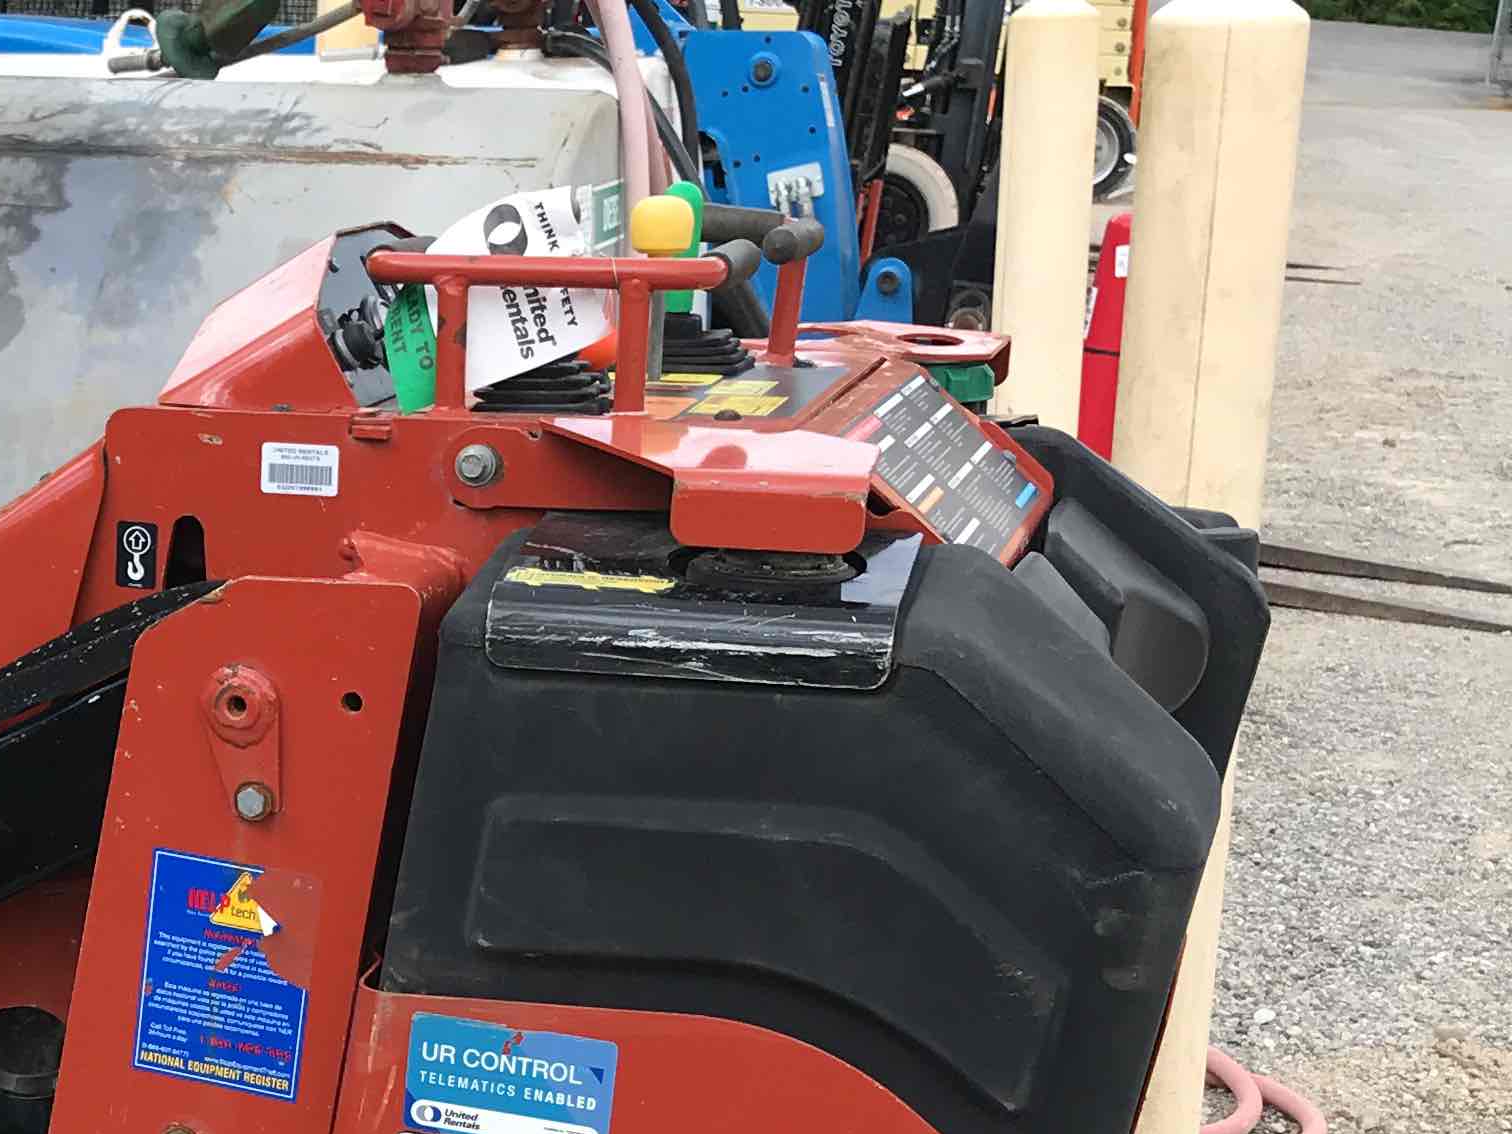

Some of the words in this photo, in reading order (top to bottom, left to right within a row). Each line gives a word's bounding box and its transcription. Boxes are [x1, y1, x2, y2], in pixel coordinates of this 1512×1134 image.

[534, 201, 560, 253] THINK
[559, 288, 578, 329] FETY
[500, 286, 536, 360] entals
[523, 286, 555, 345] nited
[415, 341, 435, 371] TO
[140, 1049, 185, 1070] NATIONAL
[188, 1059, 242, 1081] EQUIPMENT
[243, 1071, 289, 1092] REGISTER
[422, 1041, 456, 1065] UR
[463, 1048, 584, 1086] CONTROL
[419, 1070, 516, 1097] TELEMATICS
[523, 1087, 597, 1111] ENABLED
[443, 1117, 481, 1130] Rentals
[444, 1108, 479, 1121] United
